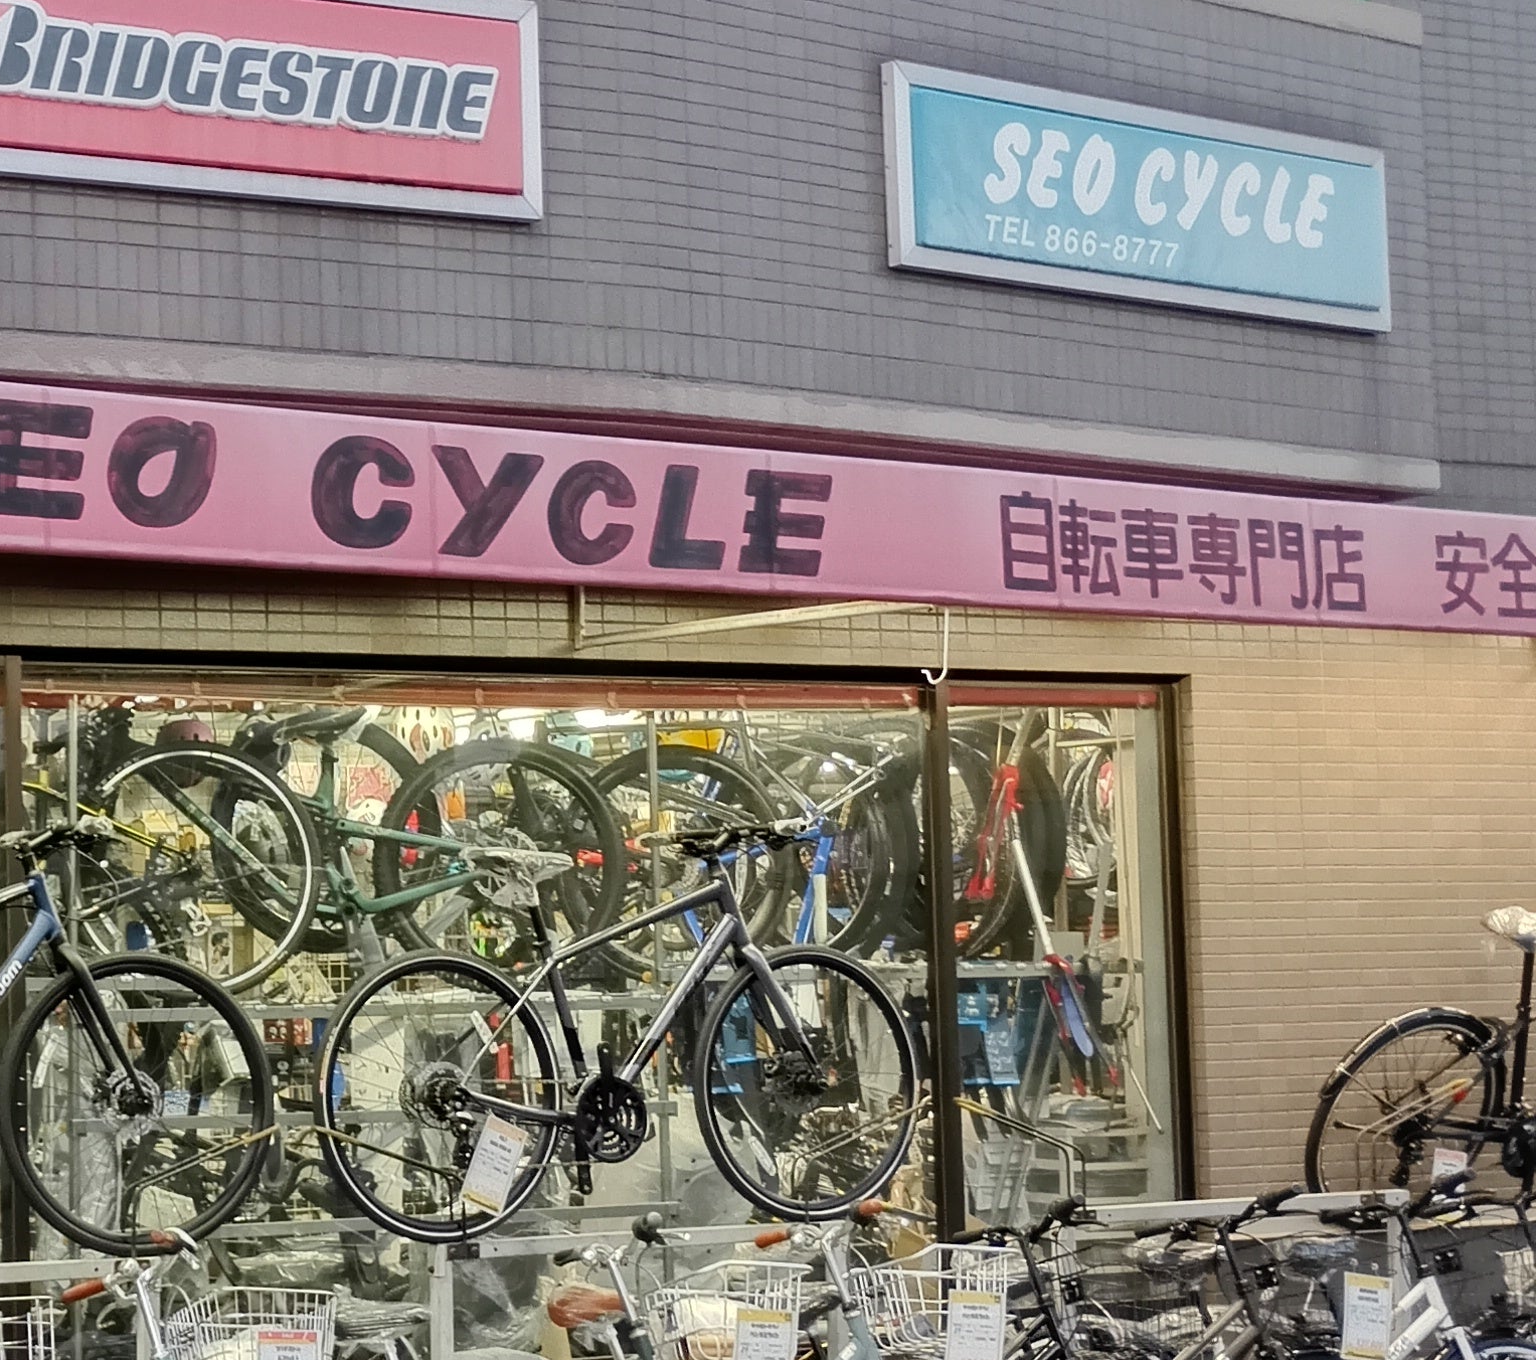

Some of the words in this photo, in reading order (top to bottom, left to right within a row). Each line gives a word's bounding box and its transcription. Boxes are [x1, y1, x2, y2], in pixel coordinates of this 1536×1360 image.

[983, 121, 1116, 216] SEO
[1134, 147, 1335, 248] CYCLE
[984, 213, 1036, 248] TEL
[1044, 224, 1180, 268] 866-8777
[310, 434, 835, 578] CYCLE
[999, 490, 1368, 613] 自転車専門店
[1434, 530, 1536, 619] 安全
